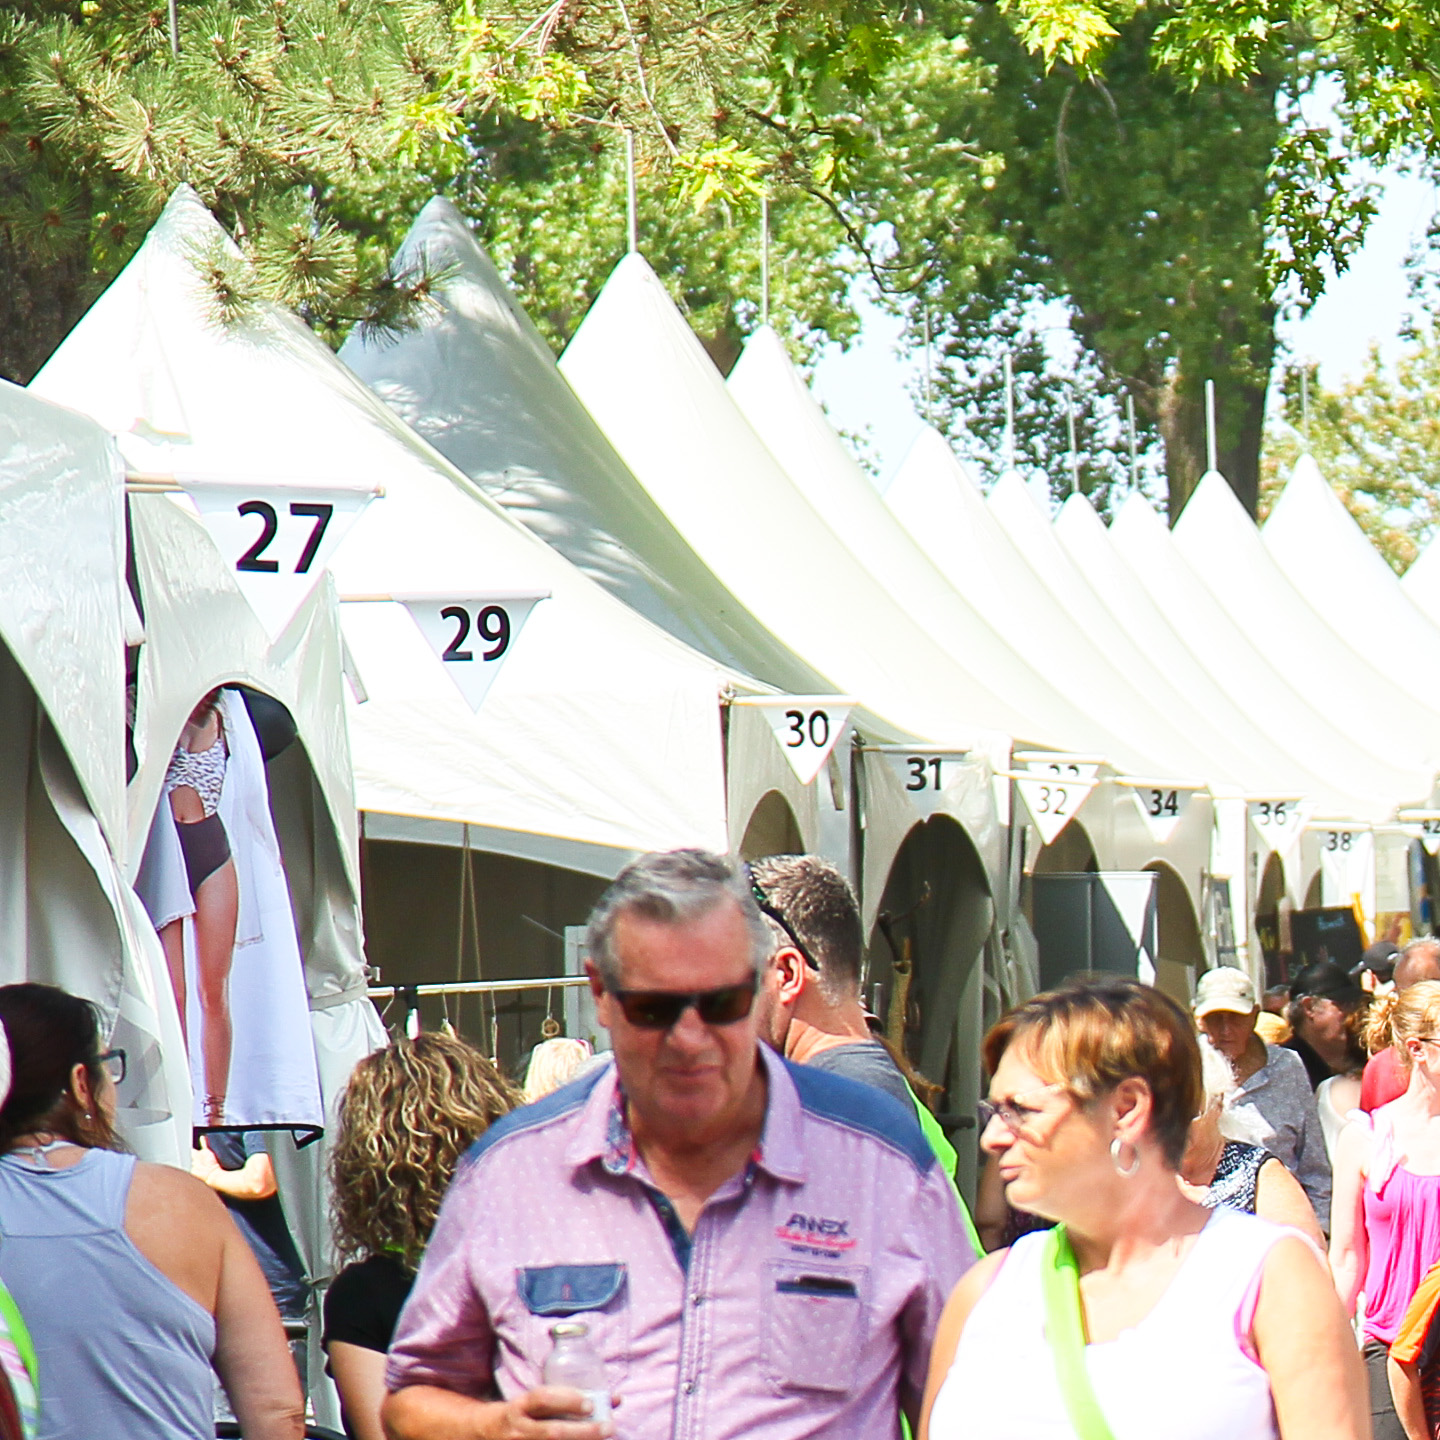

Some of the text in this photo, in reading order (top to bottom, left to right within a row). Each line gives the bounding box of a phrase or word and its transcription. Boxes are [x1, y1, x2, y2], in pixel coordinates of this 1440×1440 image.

[236, 500, 333, 573] 27
[440, 605, 511, 662] 29
[785, 709, 830, 748] 30
[905, 756, 942, 791] 31
[1037, 786, 1069, 815] 32
[1150, 789, 1179, 816] 34
[1259, 802, 1287, 826] 36
[1328, 831, 1353, 852] 38
